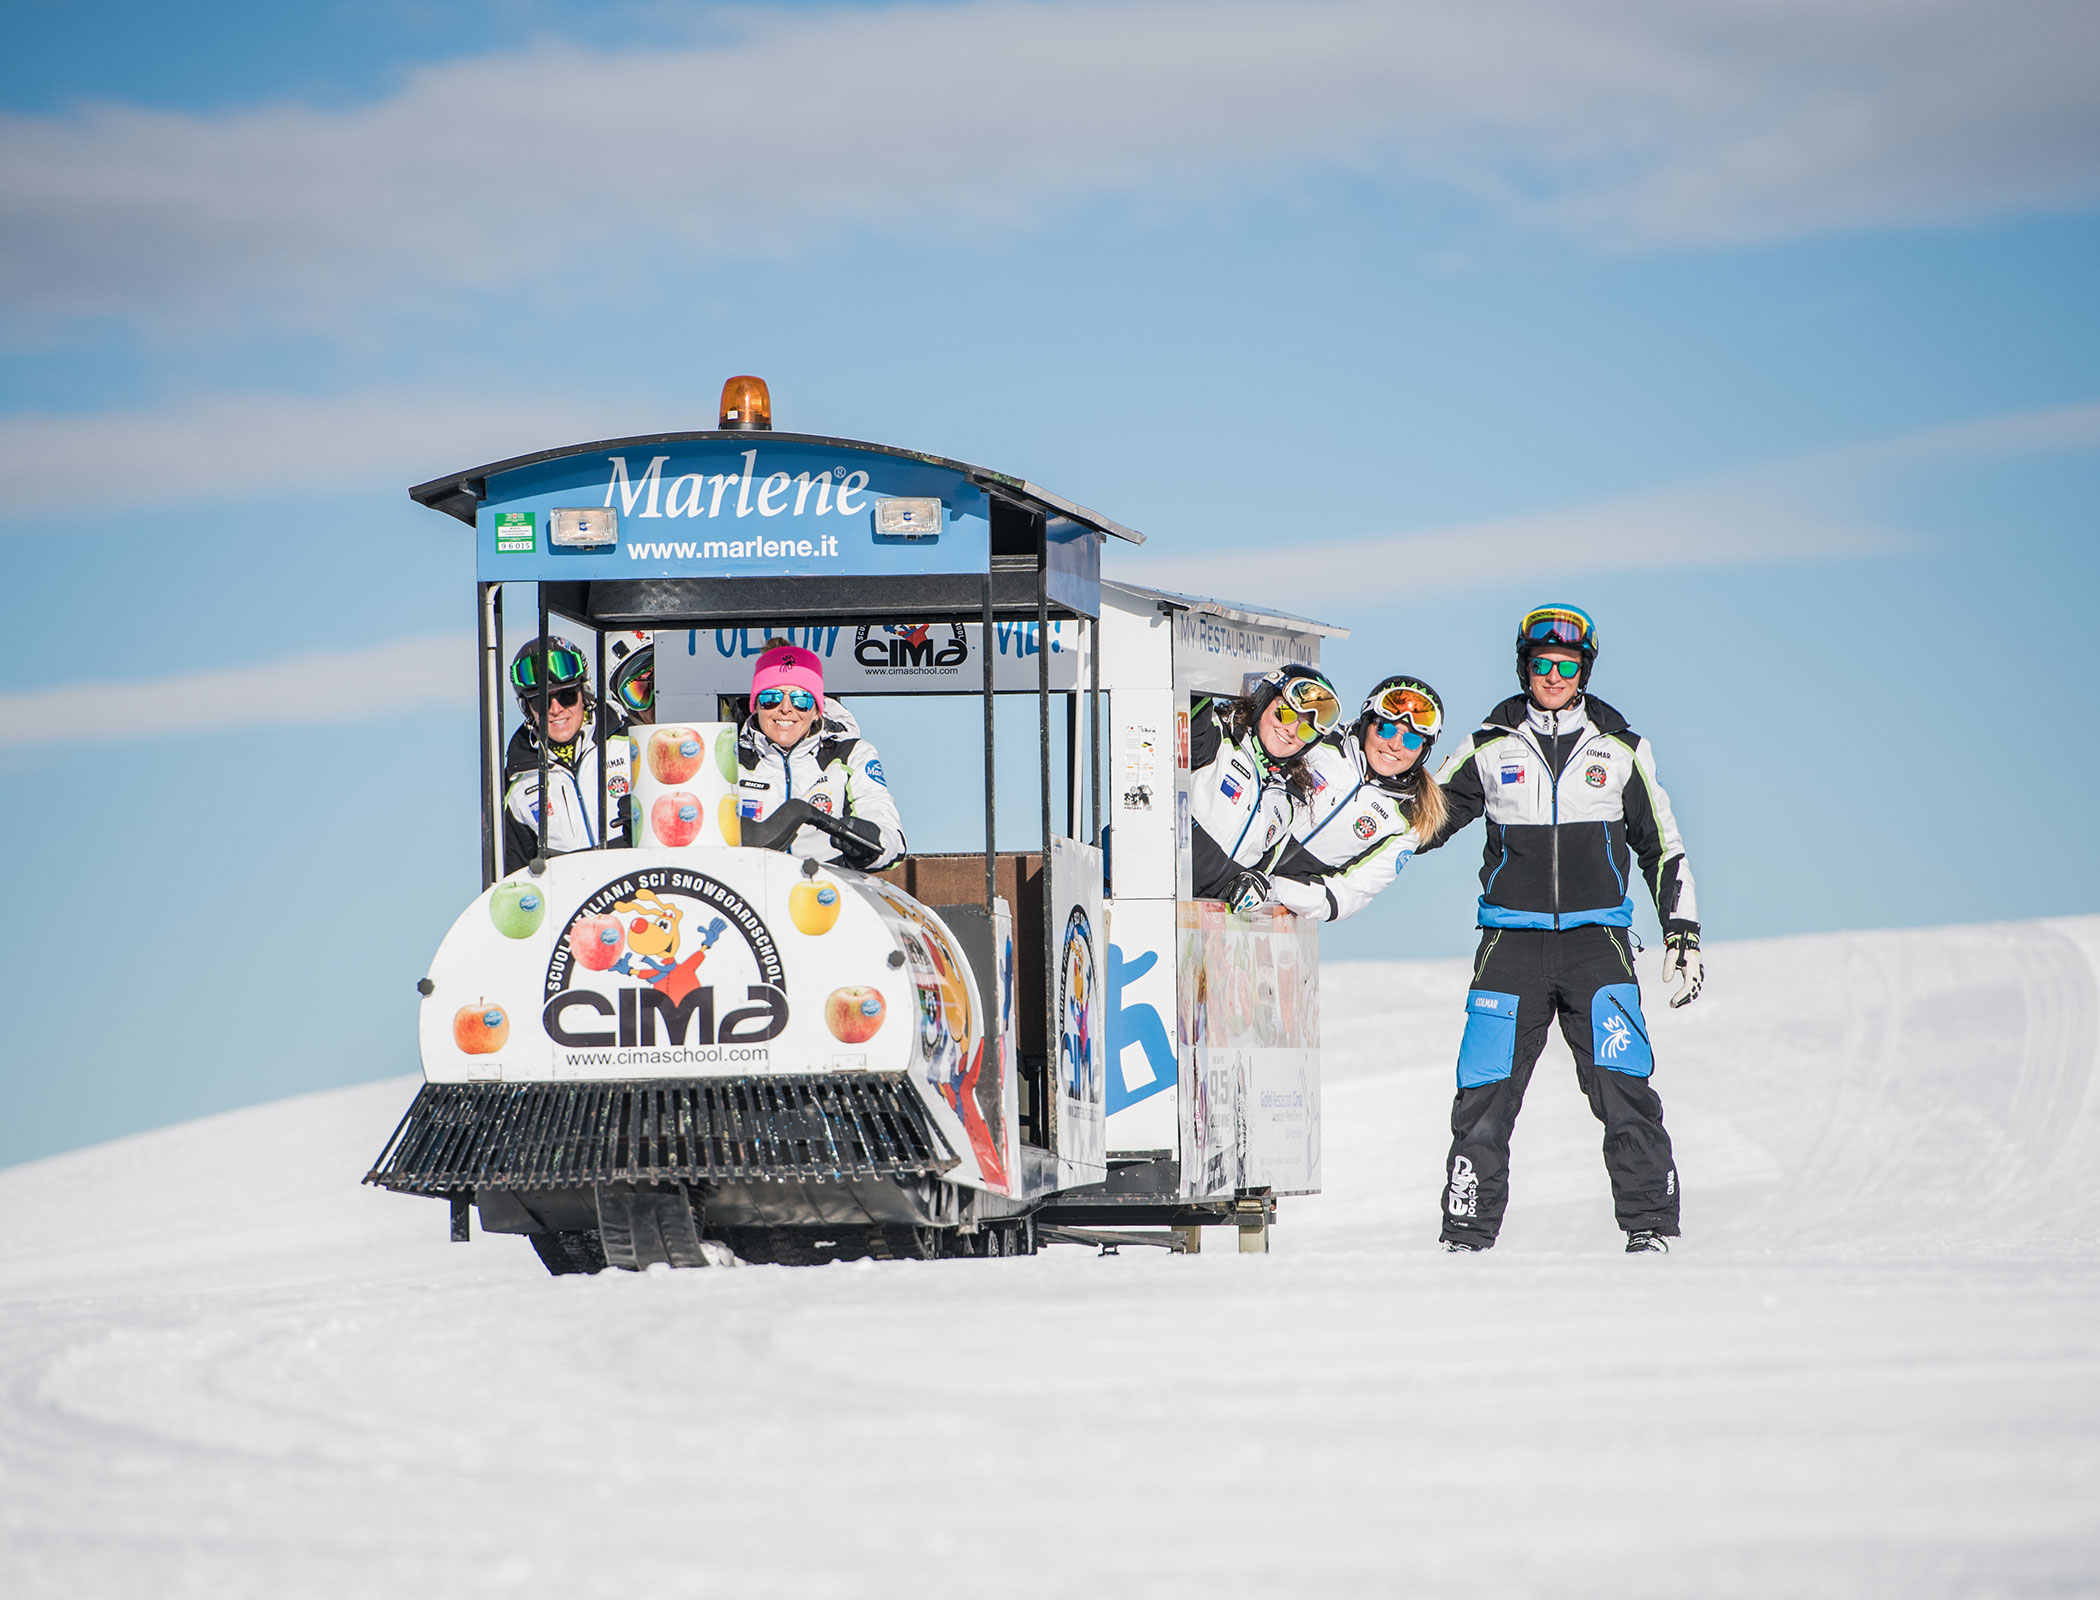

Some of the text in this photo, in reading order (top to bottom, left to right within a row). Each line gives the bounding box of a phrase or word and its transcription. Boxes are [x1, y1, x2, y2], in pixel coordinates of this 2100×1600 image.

[627, 535, 838, 560] www.marlene.it
[865, 667, 958, 676] www.cimaschool.com
[638, 873, 667, 889] SCI
[671, 873, 783, 984] SNOWBOARDSCHOOL
[566, 1047, 769, 1066] www.cimaschool.com
